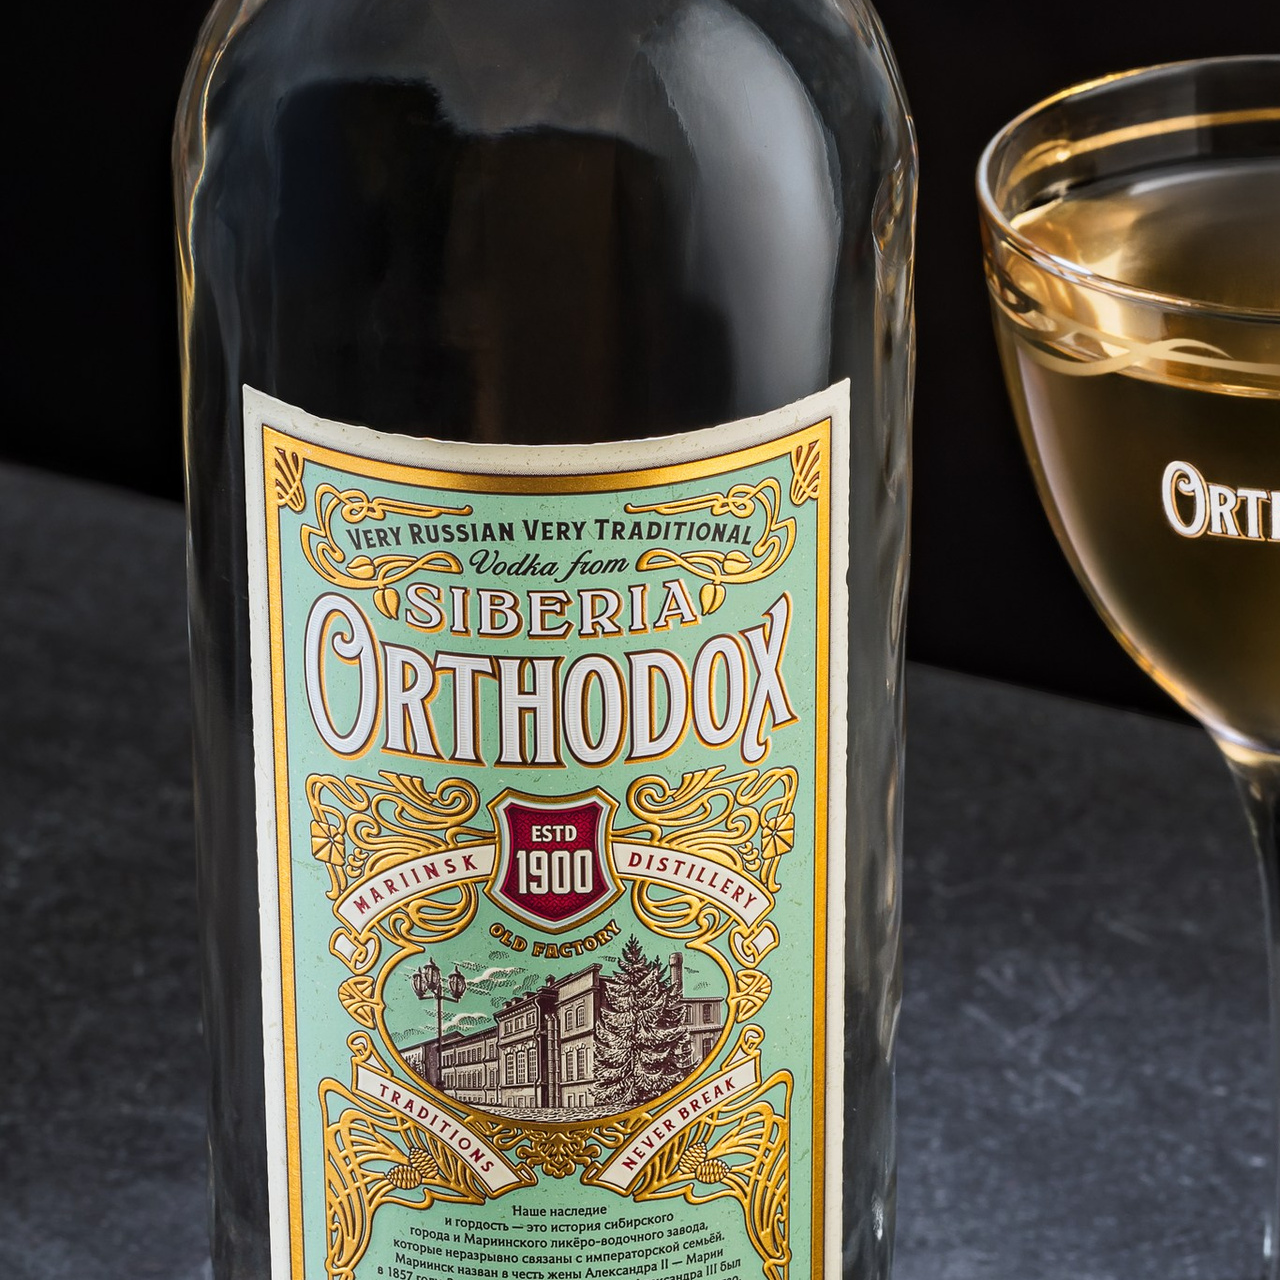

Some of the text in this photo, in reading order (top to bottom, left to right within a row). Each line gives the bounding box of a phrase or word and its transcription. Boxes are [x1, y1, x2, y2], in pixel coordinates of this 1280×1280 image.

[468, 549, 630, 583] Vodka from
[404, 579, 701, 640] SIBERIA
[303, 591, 799, 769] ORTHODOX
[531, 825, 577, 843] ESTD
[353, 854, 478, 915] MARIINSK
[516, 849, 594, 895] 1900
[627, 852, 757, 910] DISTILLERY
[488, 919, 622, 958] OLD FACTORY
[379, 1083, 495, 1173] TRADITIONS
[621, 1076, 737, 1171] NEVER BREAK
[445, 1217, 452, 1225] и
[455, 1219, 509, 1232] гордость
[527, 1224, 547, 1232] это
[551, 1223, 601, 1234] история
[604, 1213, 674, 1230] сибирского
[512, 1205, 607, 1217] Наше наследие
[393, 1239, 442, 1255] которые
[446, 1249, 518, 1264] неразрывно
[522, 1255, 572, 1264] связаны
[586, 1241, 680, 1263] императорской
[683, 1232, 725, 1249] семьёй.
[410, 1226, 450, 1242] города
[464, 1233, 547, 1248] Мариинского
[551, 1230, 664, 1248] ликёро-водочного
[667, 1221, 708, 1238] завода,
[378, 1266, 383, 1275] в
[388, 1267, 413, 1280] 1857
[706, 1264, 717, 1276] III
[720, 1258, 741, 1272] был
[395, 1253, 454, 1272] Мариинск
[458, 1267, 498, 1277] назван
[502, 1271, 508, 1279] в
[512, 1271, 544, 1280] честь
[547, 1271, 582, 1279] жены
[585, 1262, 657, 1279] Александра
[661, 1259, 669, 1269] II
[686, 1248, 724, 1265] Марии
